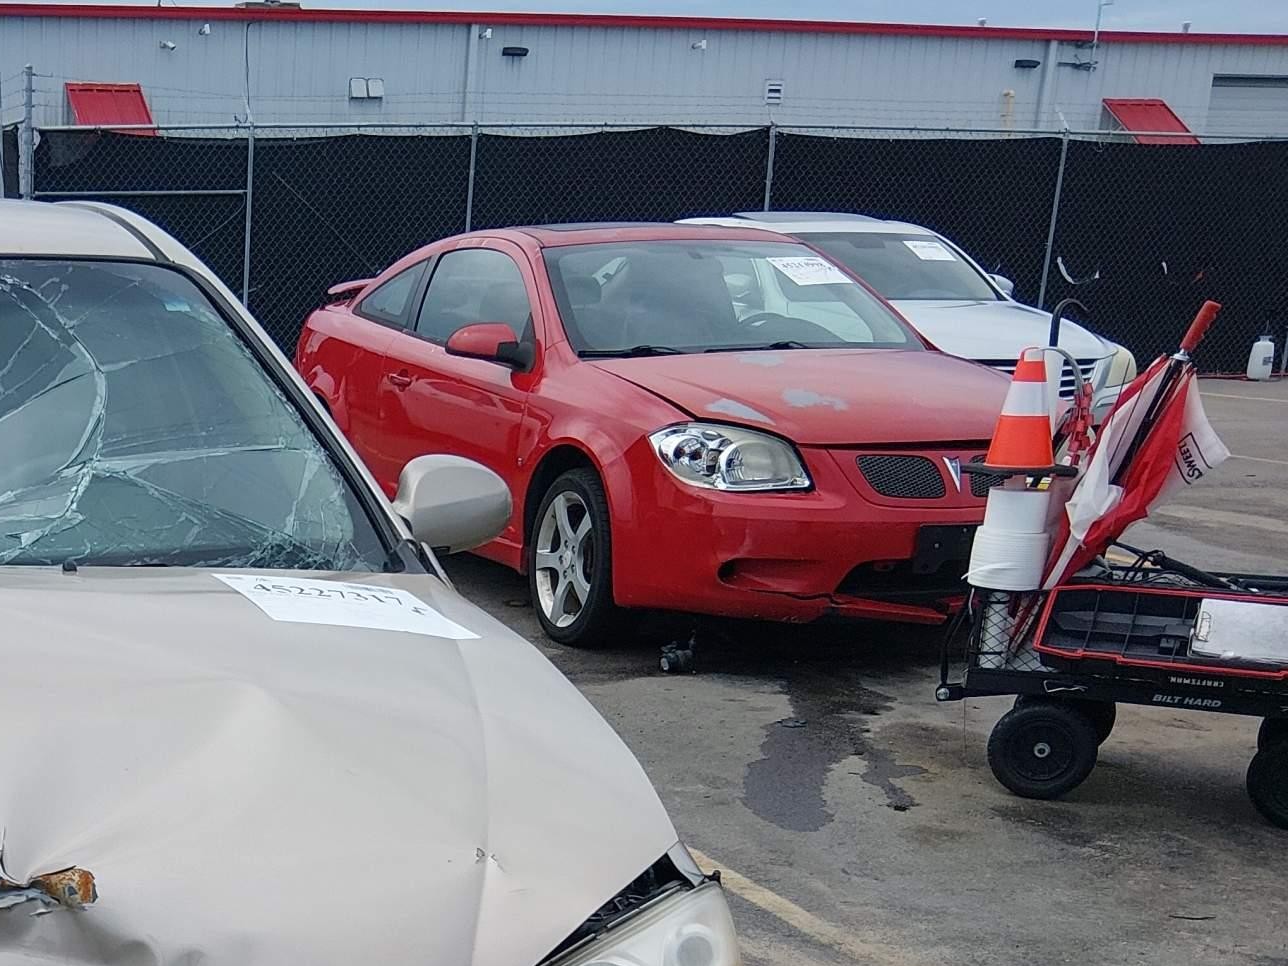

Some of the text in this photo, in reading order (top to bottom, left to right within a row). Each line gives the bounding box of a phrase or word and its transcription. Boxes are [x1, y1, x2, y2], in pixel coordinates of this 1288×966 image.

[253, 583, 403, 606] 45227317
[1152, 694, 1222, 708] BILT HARD
